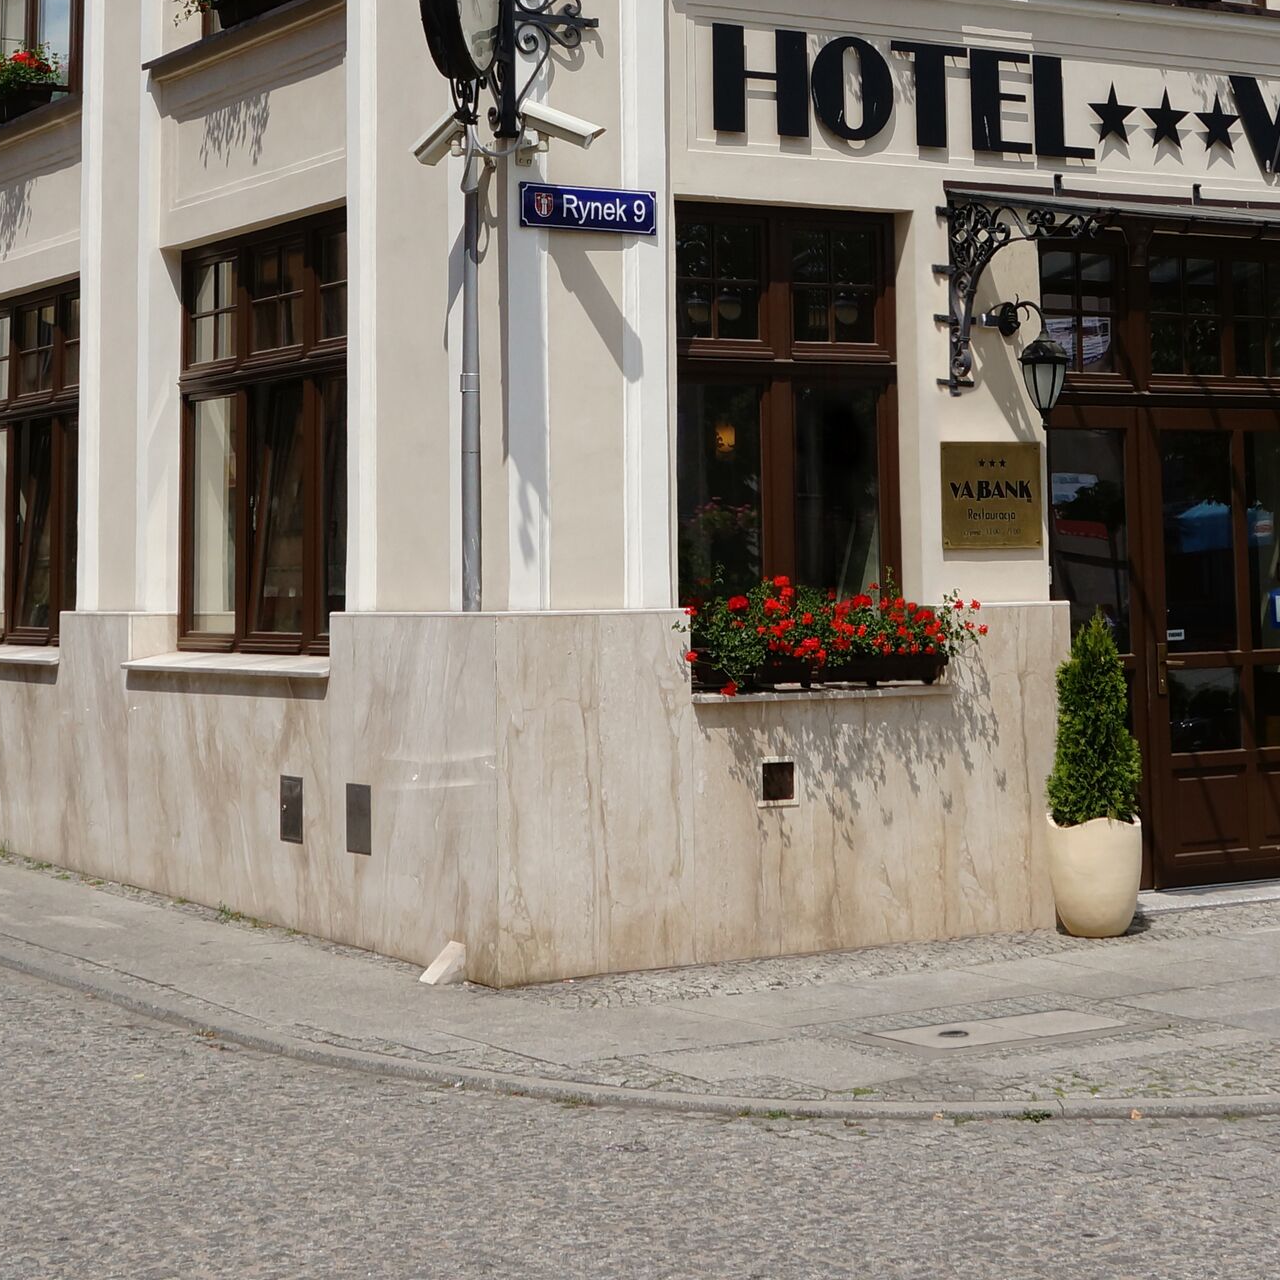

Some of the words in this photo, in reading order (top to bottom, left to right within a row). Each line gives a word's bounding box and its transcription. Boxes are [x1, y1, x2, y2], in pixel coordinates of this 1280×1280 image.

[713, 23, 1095, 160] HOTEL
[563, 194, 627, 224] Rynek
[633, 200, 646, 222] 9
[967, 507, 1016, 522] Restauracja
